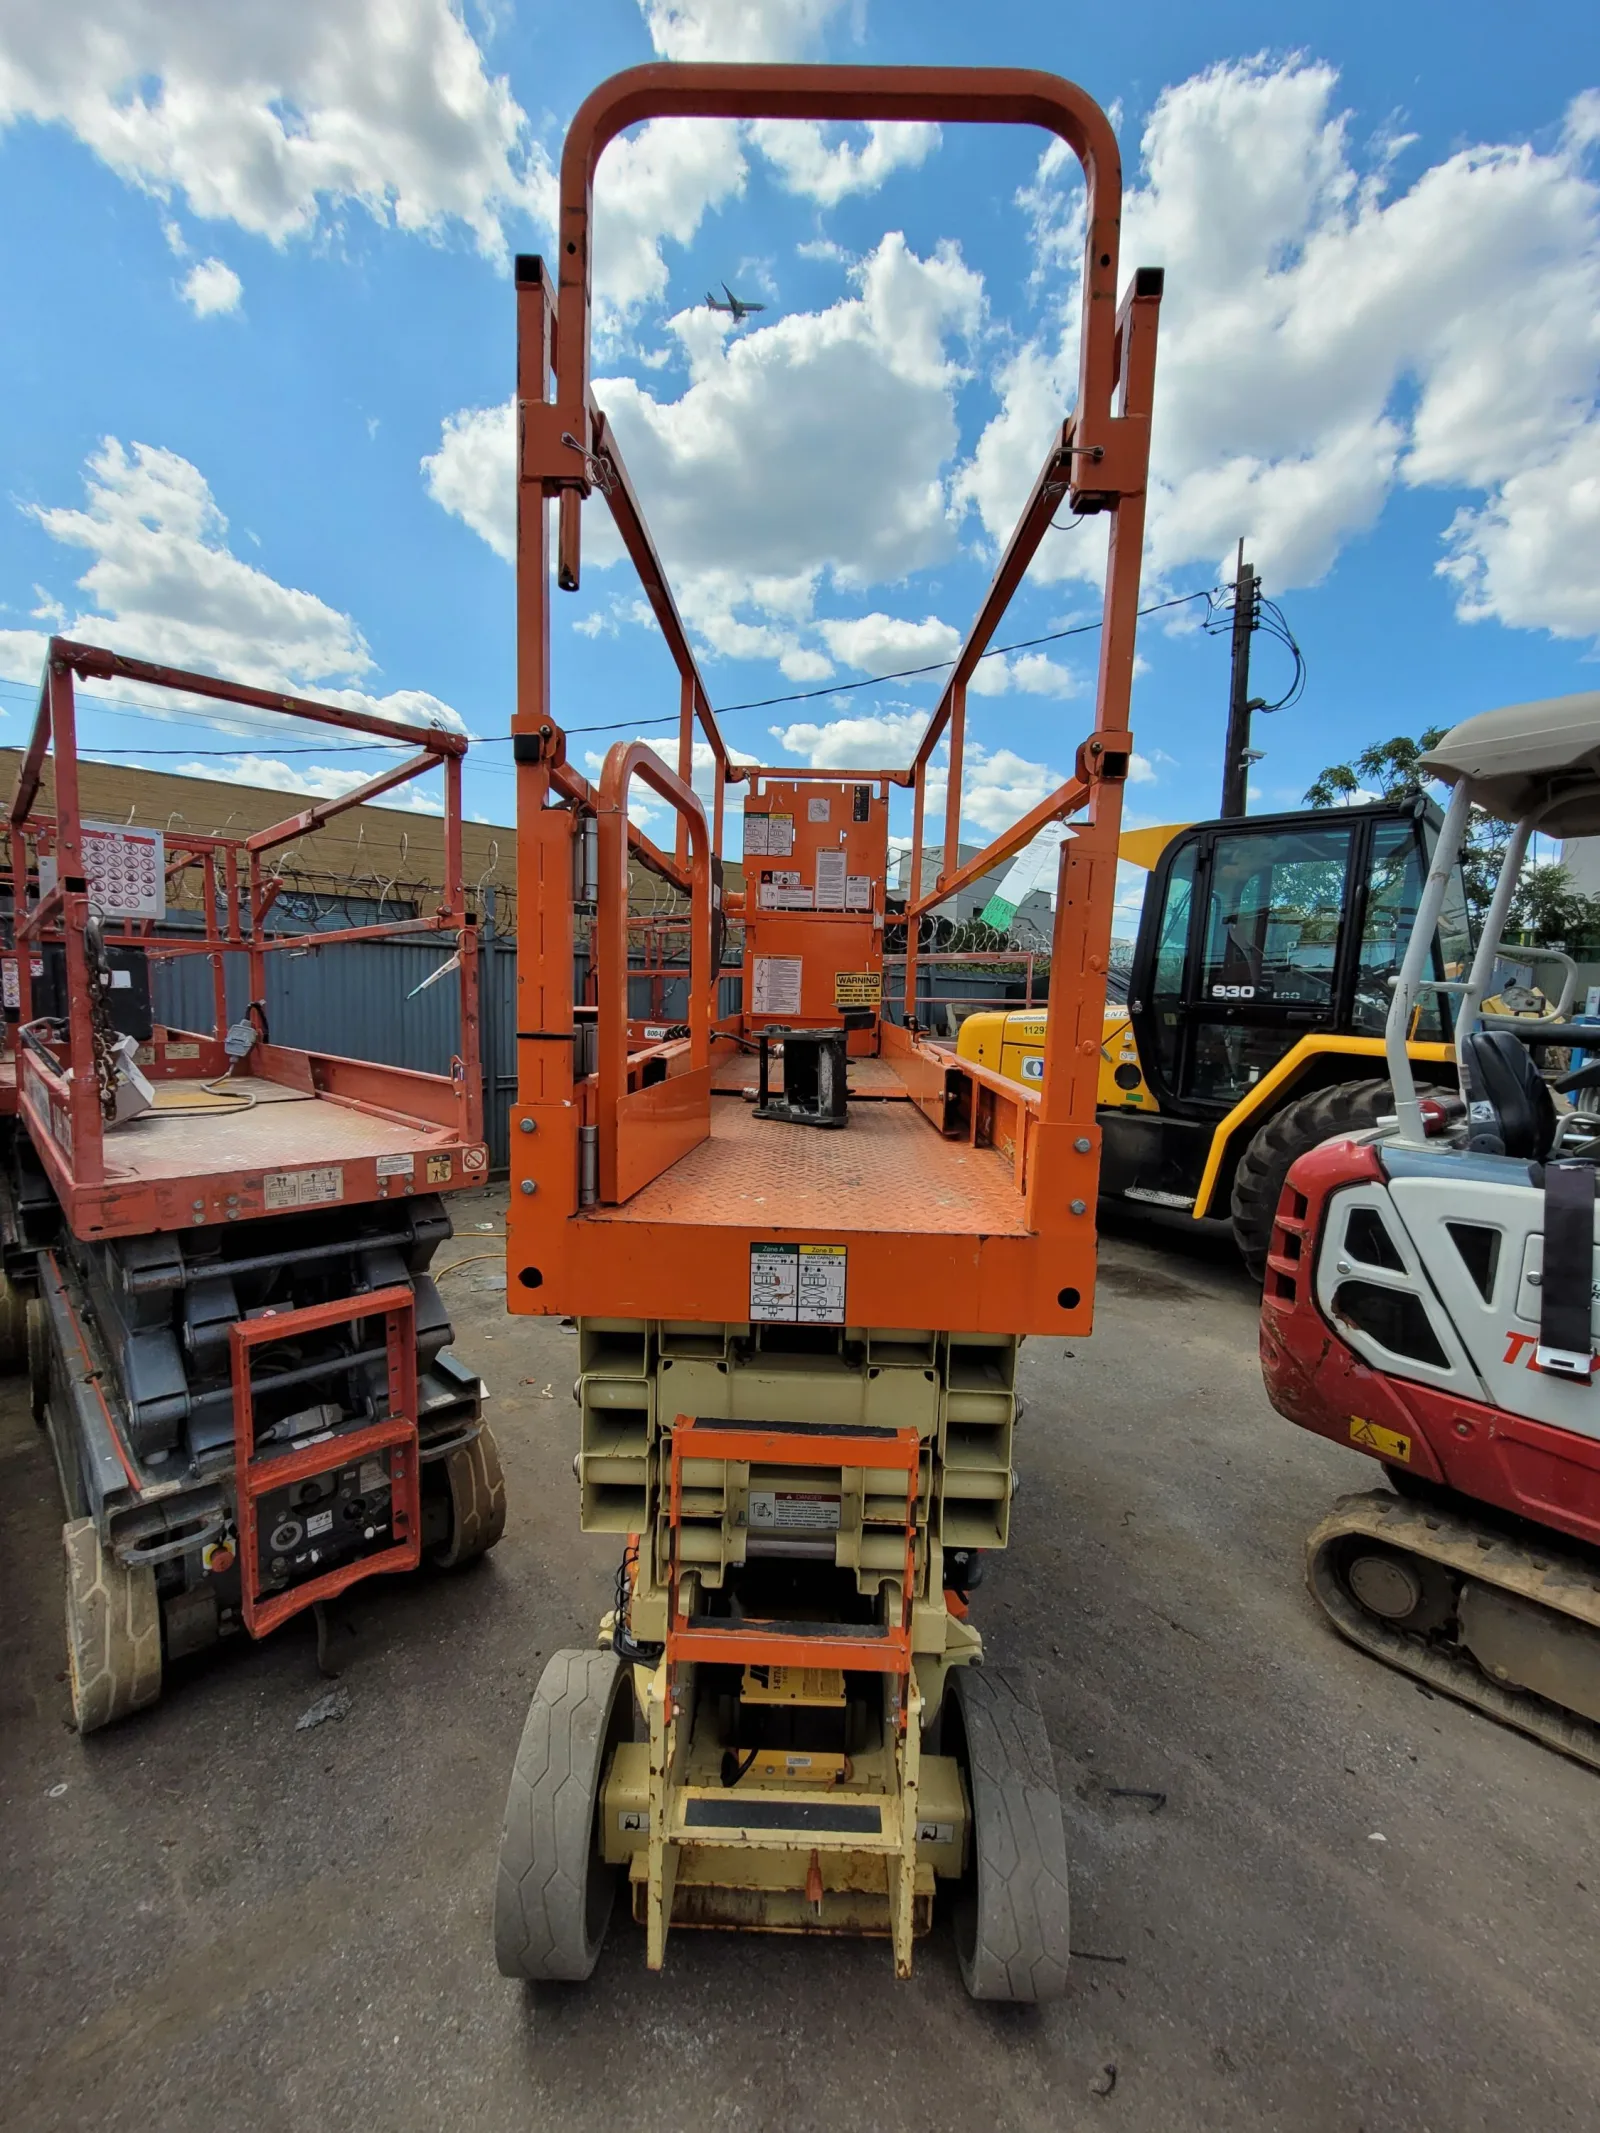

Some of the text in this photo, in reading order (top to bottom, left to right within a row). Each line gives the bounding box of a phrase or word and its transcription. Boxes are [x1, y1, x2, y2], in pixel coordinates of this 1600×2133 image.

[838, 976, 879, 984] WARNING
[1212, 985, 1255, 998] 930
[1023, 1025, 1047, 1035] 1129
